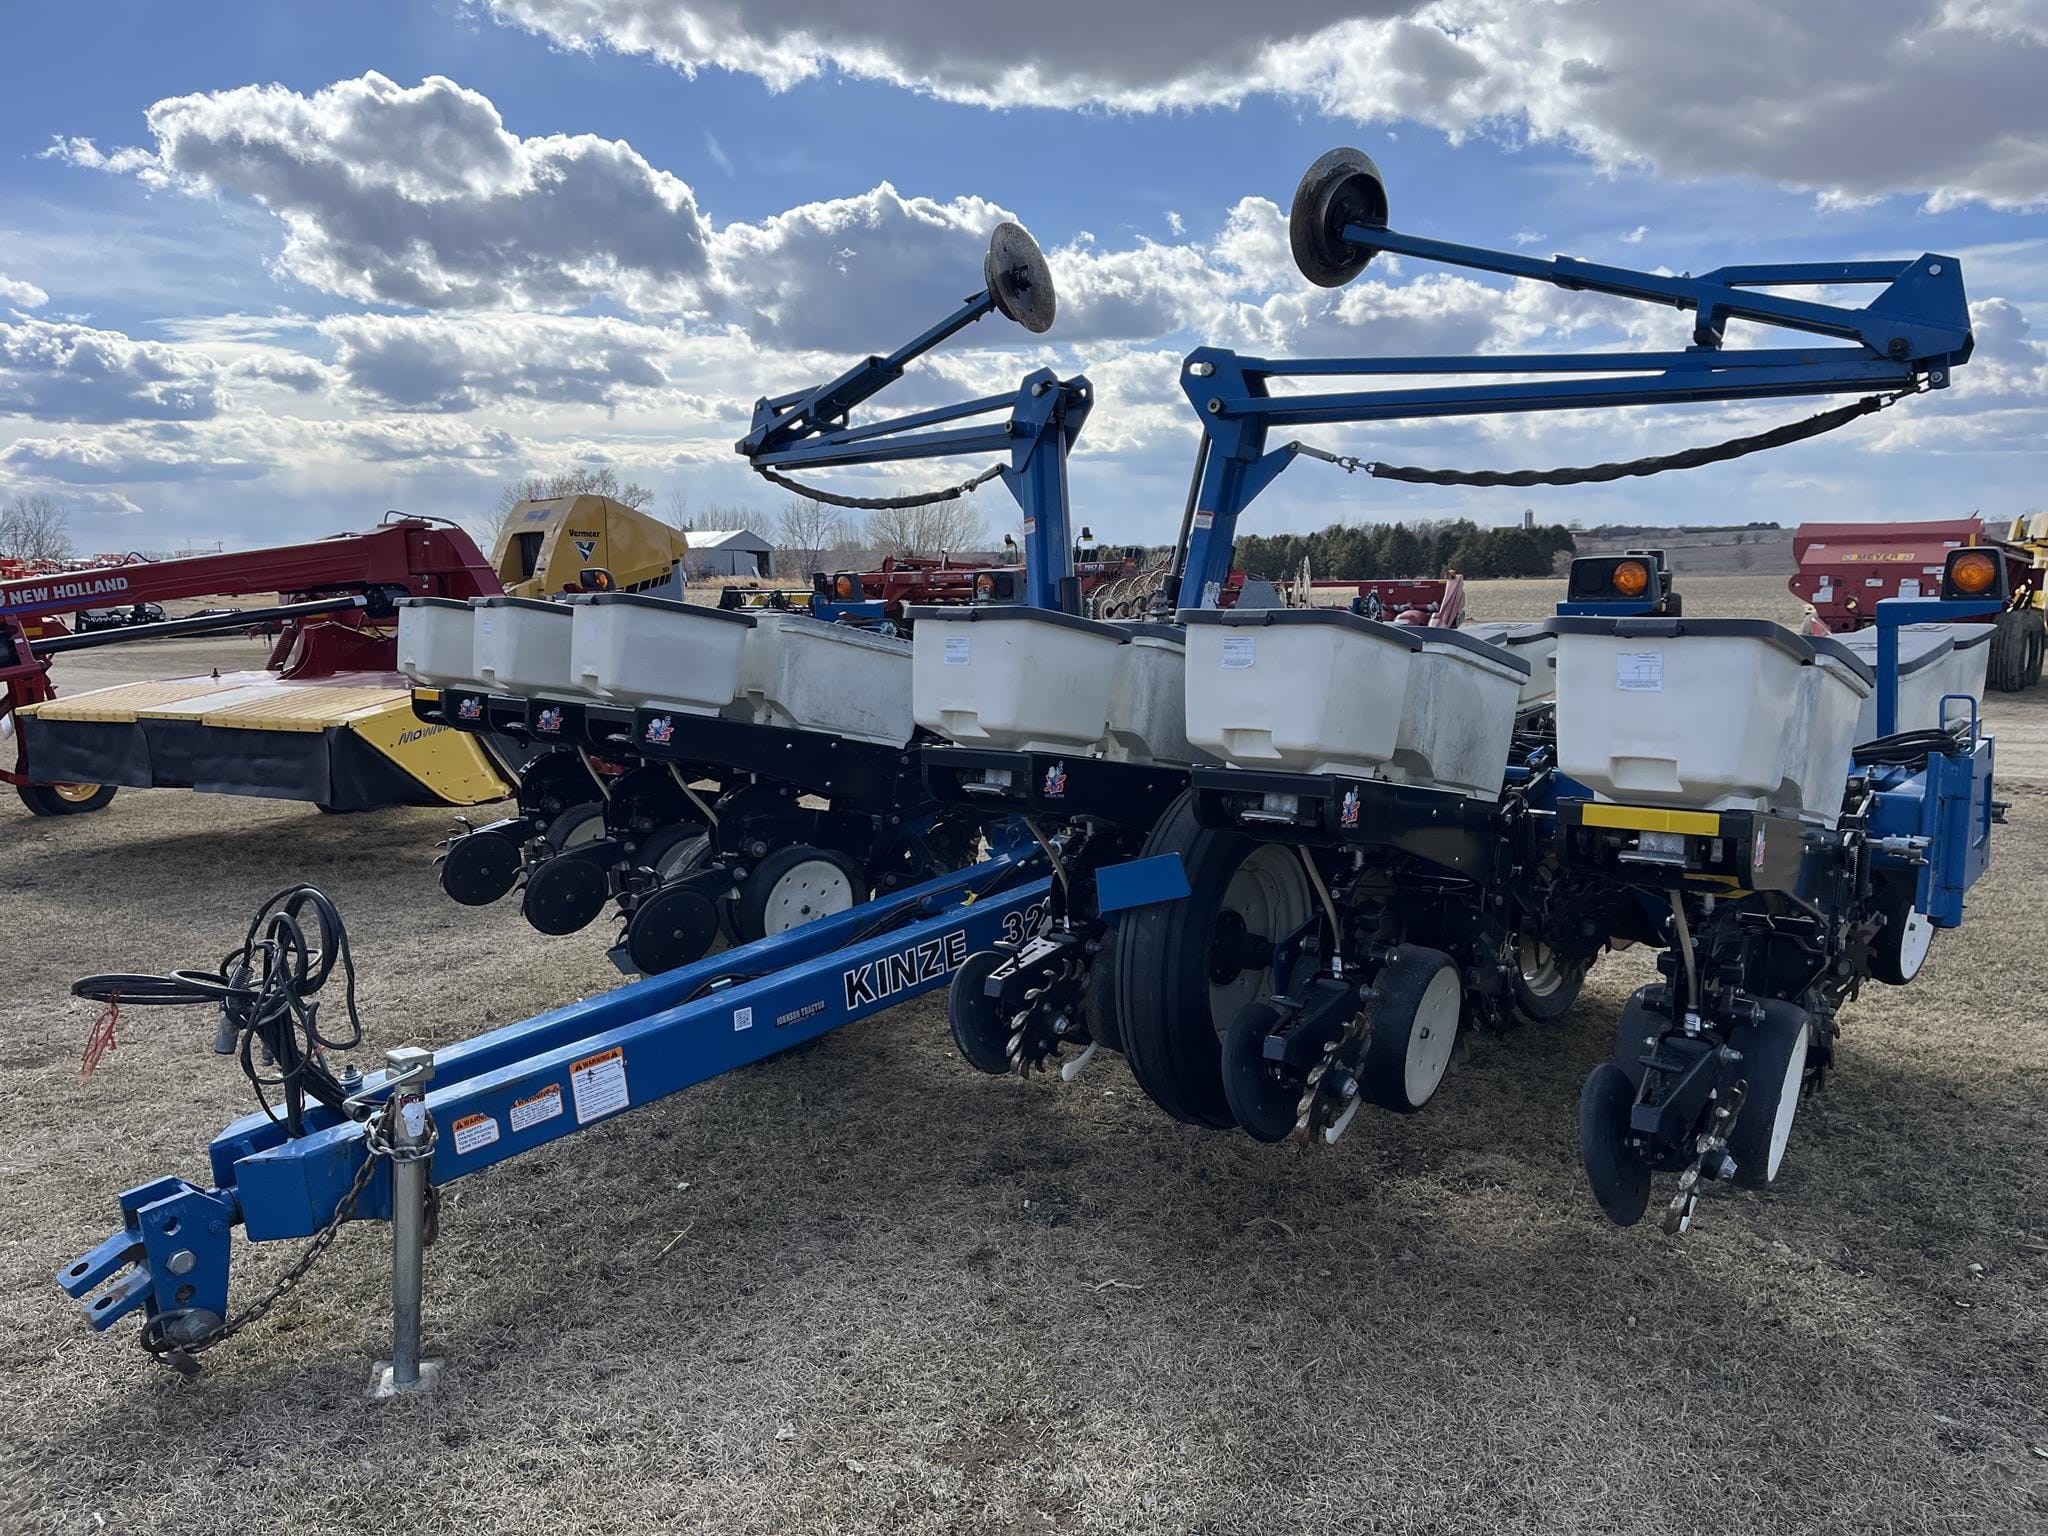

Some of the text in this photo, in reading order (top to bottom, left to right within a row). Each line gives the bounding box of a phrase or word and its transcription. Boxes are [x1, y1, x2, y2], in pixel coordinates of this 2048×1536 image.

[569, 528, 600, 538] Vermeer
[9, 577, 128, 605] NEW HOLLAND
[844, 929, 968, 1010] KINZE
[776, 1010, 800, 1027] JOHNSON
[800, 1000, 825, 1017] TRACTOR
[582, 1053, 611, 1069] WARNING
